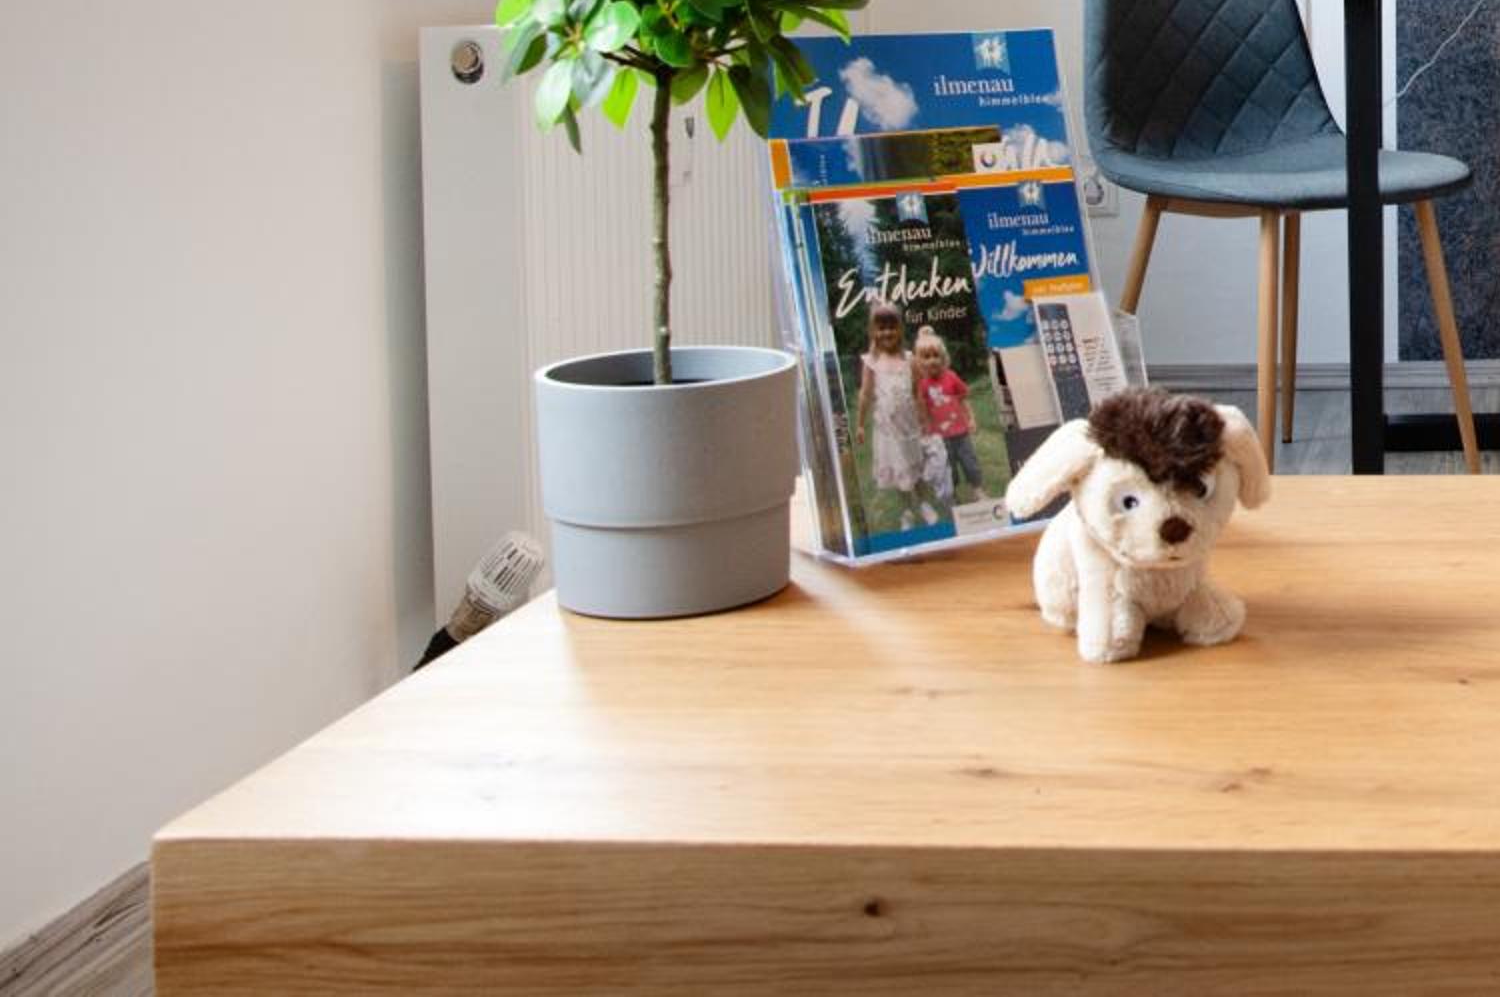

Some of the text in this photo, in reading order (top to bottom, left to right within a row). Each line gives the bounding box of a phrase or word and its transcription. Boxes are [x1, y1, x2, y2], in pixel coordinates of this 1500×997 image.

[933, 75, 1014, 97] ilmenau
[987, 212, 1049, 231] ilmenau
[835, 255, 973, 318] Entdecken
